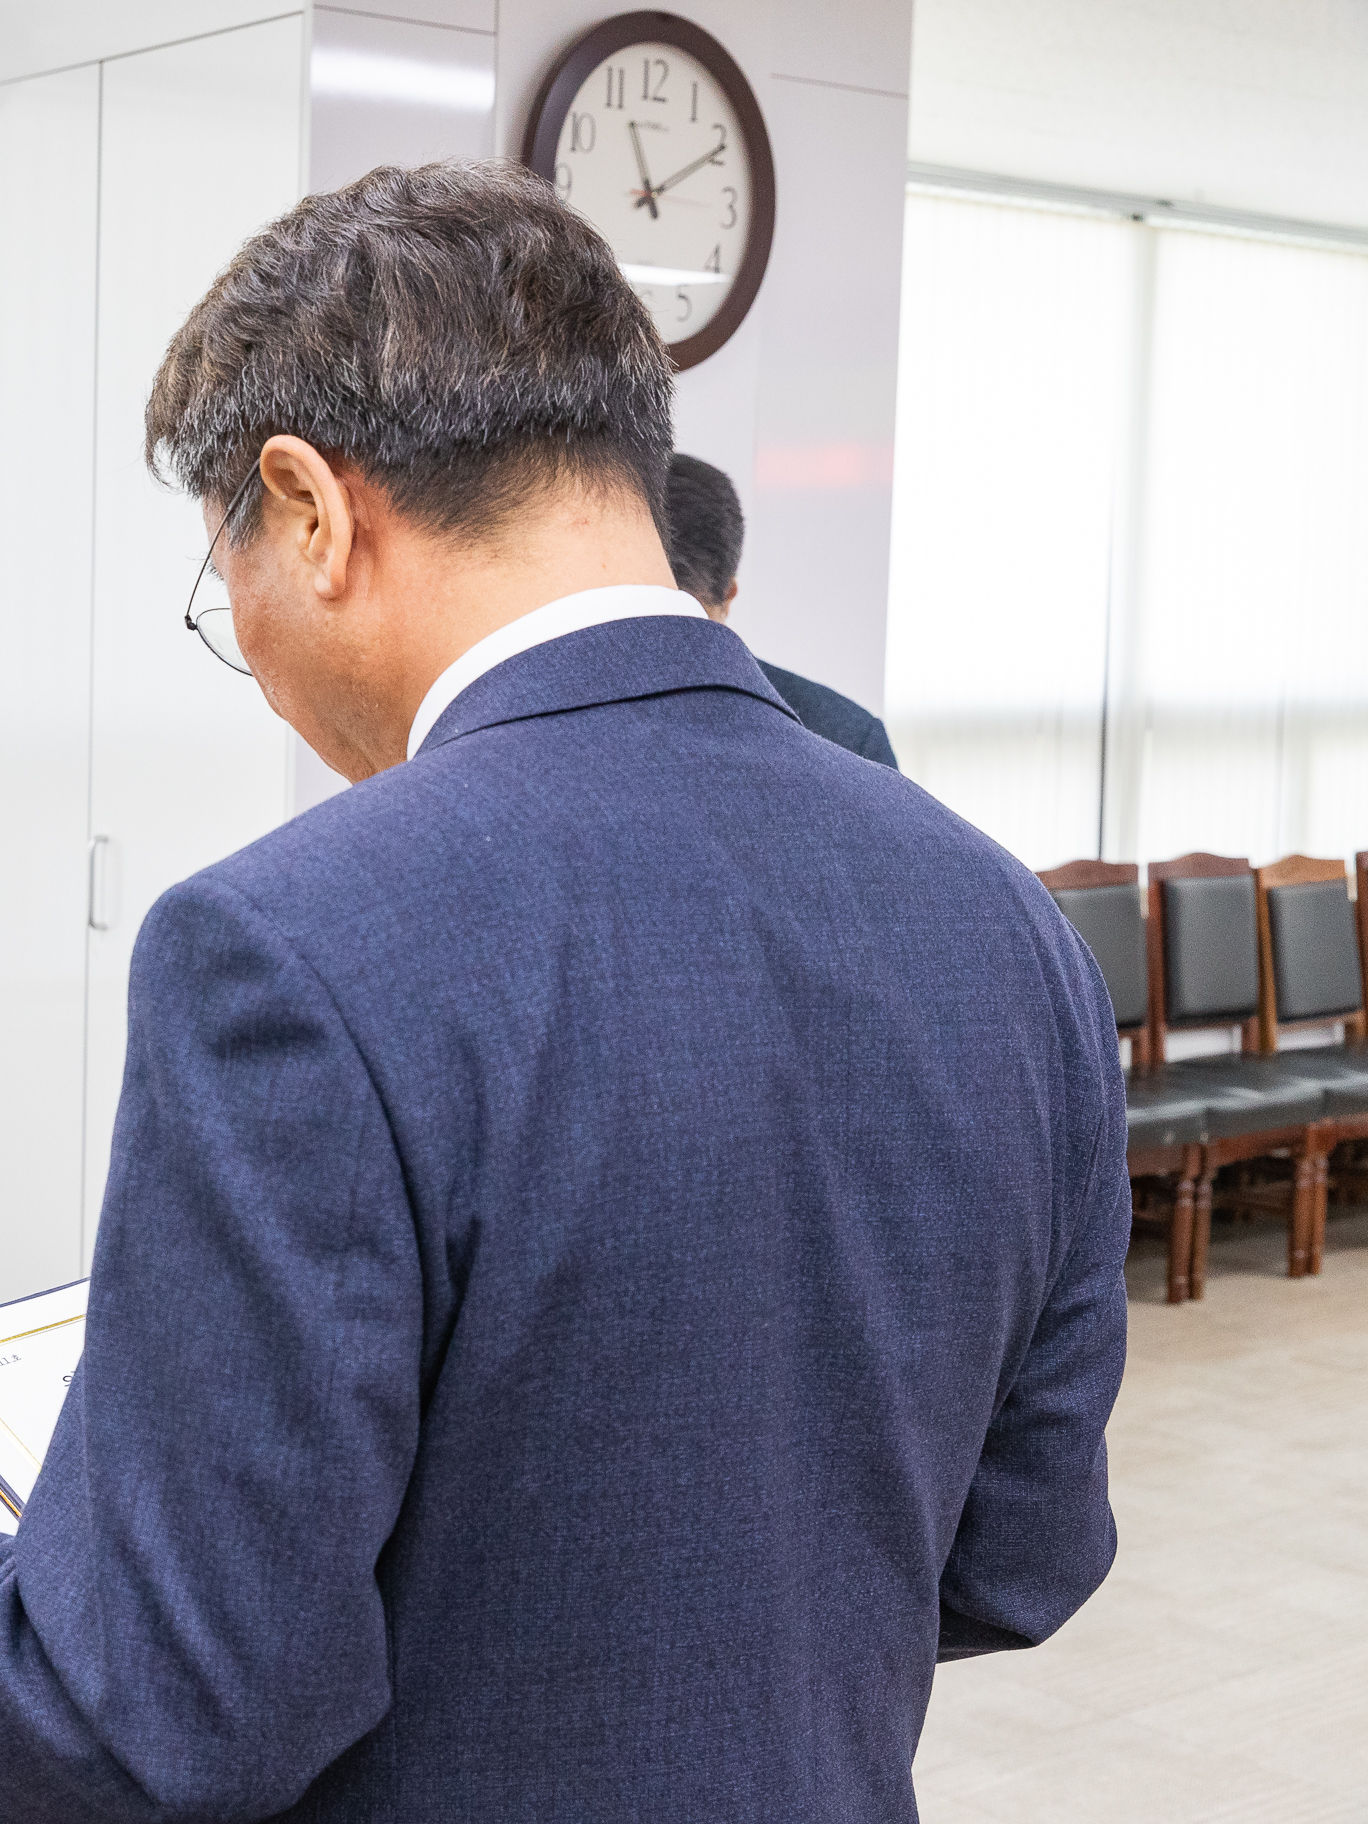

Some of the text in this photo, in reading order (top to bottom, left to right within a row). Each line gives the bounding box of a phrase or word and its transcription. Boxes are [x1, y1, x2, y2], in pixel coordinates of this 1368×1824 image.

[605, 66, 625, 110] 11
[642, 58, 669, 103] 12
[690, 81, 699, 123] 1
[568, 112, 596, 154] 10
[708, 123, 728, 166] 2
[556, 162, 573, 204] 9
[720, 187, 738, 230] 3
[704, 243, 722, 274] 4
[676, 283, 693, 322] 5
